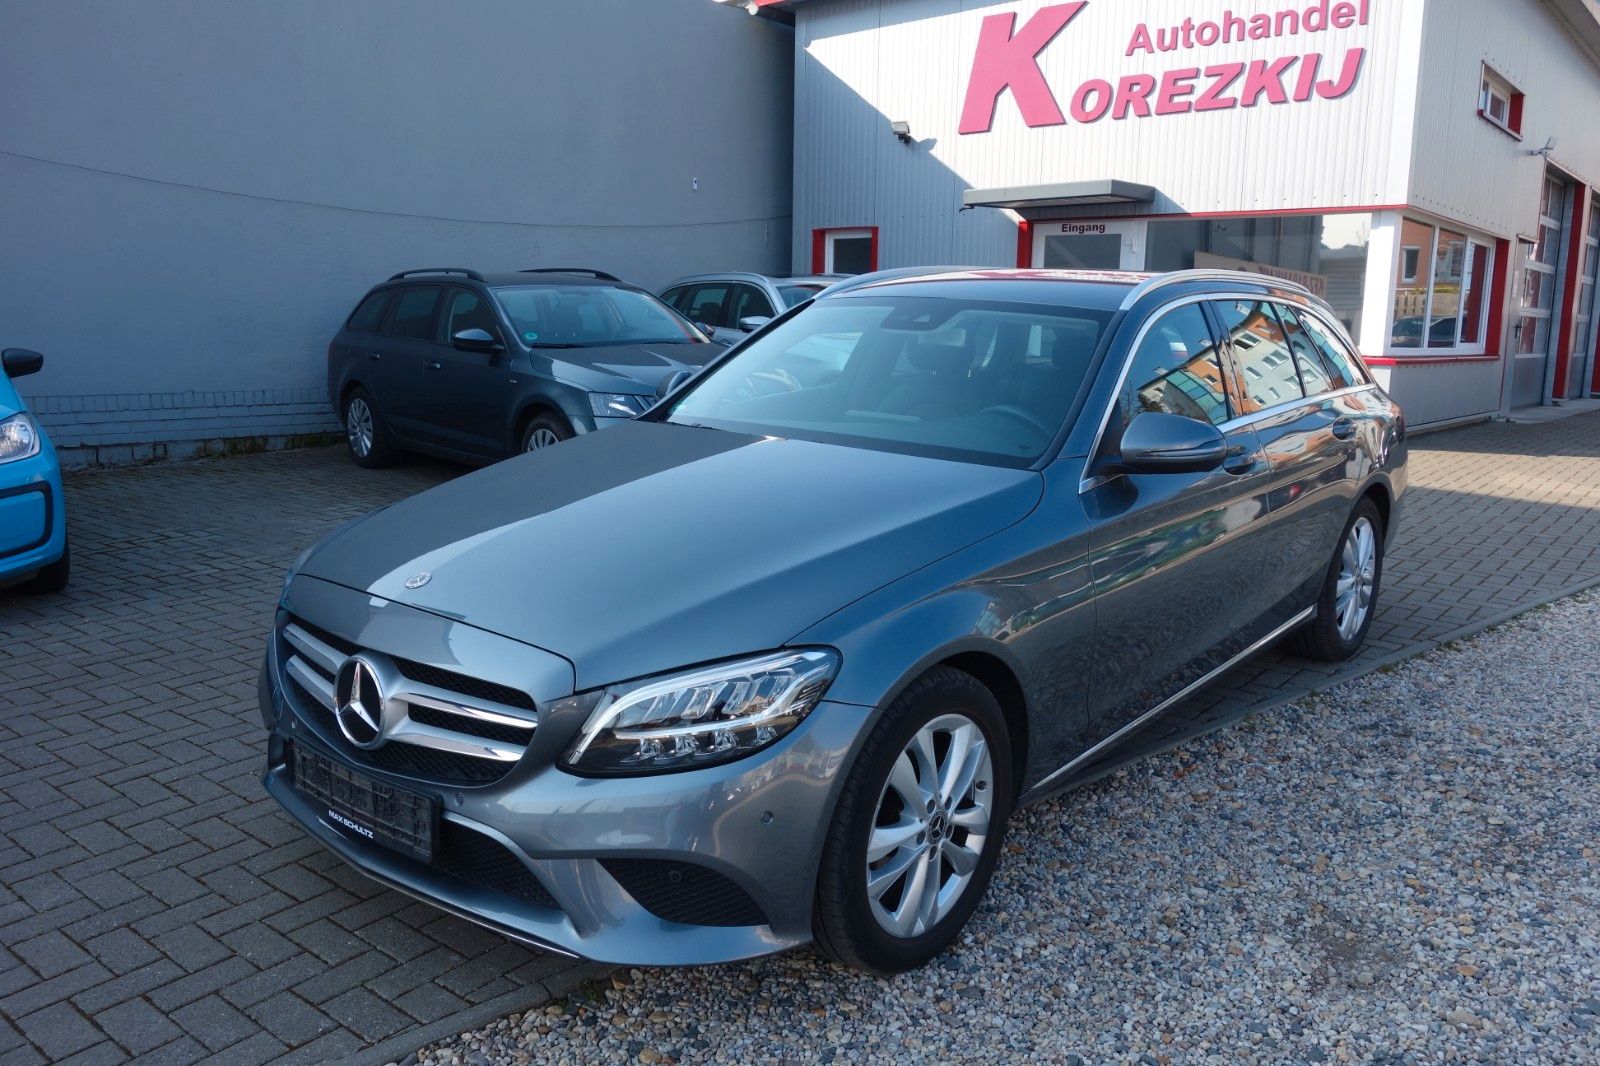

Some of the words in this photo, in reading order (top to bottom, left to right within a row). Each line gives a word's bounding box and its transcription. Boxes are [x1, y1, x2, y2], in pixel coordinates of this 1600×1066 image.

[1125, 0, 1369, 56] Autohandel
[958, 1, 1366, 135] KOREZKIJ
[1061, 223, 1106, 234] Eingang
[328, 809, 344, 824] MAX
[343, 818, 374, 839] SCHULTZ
